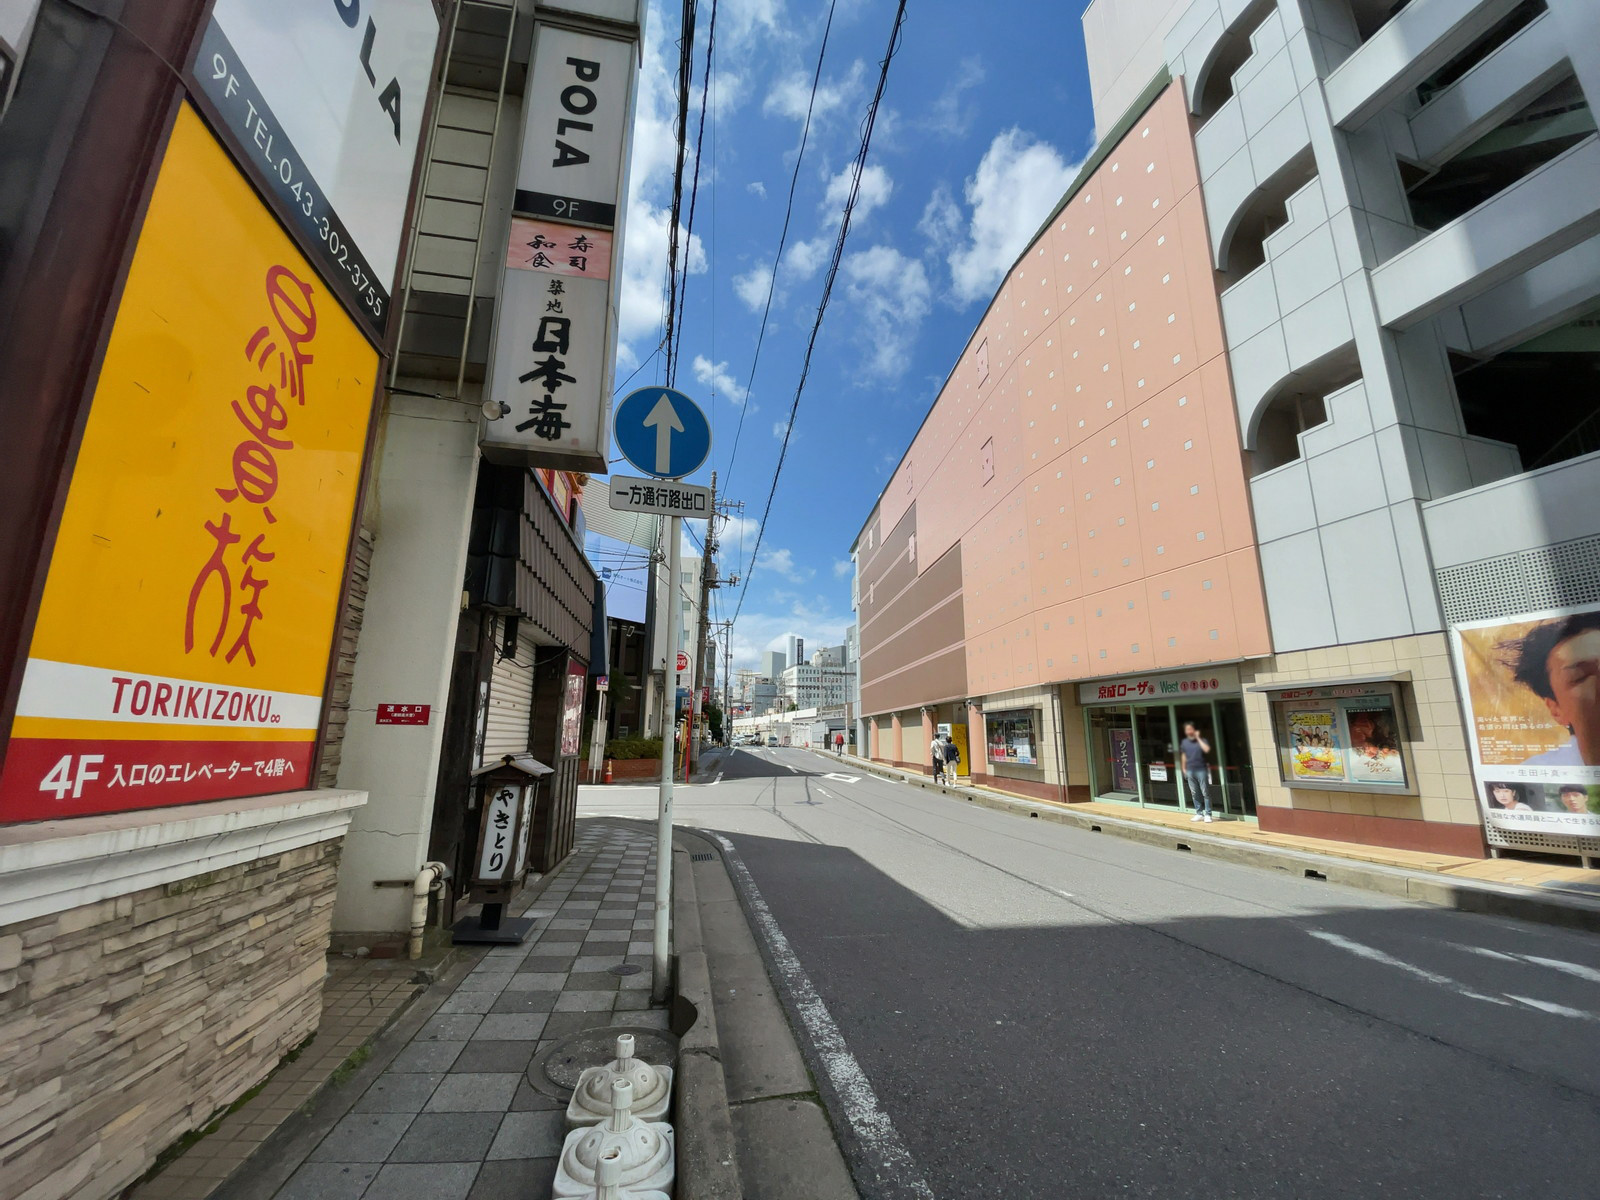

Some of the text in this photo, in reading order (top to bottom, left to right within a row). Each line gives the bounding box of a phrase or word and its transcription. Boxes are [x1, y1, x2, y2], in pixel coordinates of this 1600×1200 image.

[552, 56, 601, 169] POLA
[211, 53, 383, 318] 9F TEL.043-302-3755
[552, 199, 580, 219] 9F
[527, 235, 555, 271] 和食
[567, 234, 594, 272] 寿司
[516, 316, 577, 442] 日本海
[615, 485, 706, 513] 一方通行路出口
[110, 676, 273, 724] TORIKIZOKU
[1159, 680, 1180, 694] West
[39, 754, 295, 801] 4F 入口のエレベーターで4階へ
[1119, 740, 1129, 778] ウエスト
[1517, 768, 1561, 777] 生田斗真
[488, 788, 514, 872] やきとり
